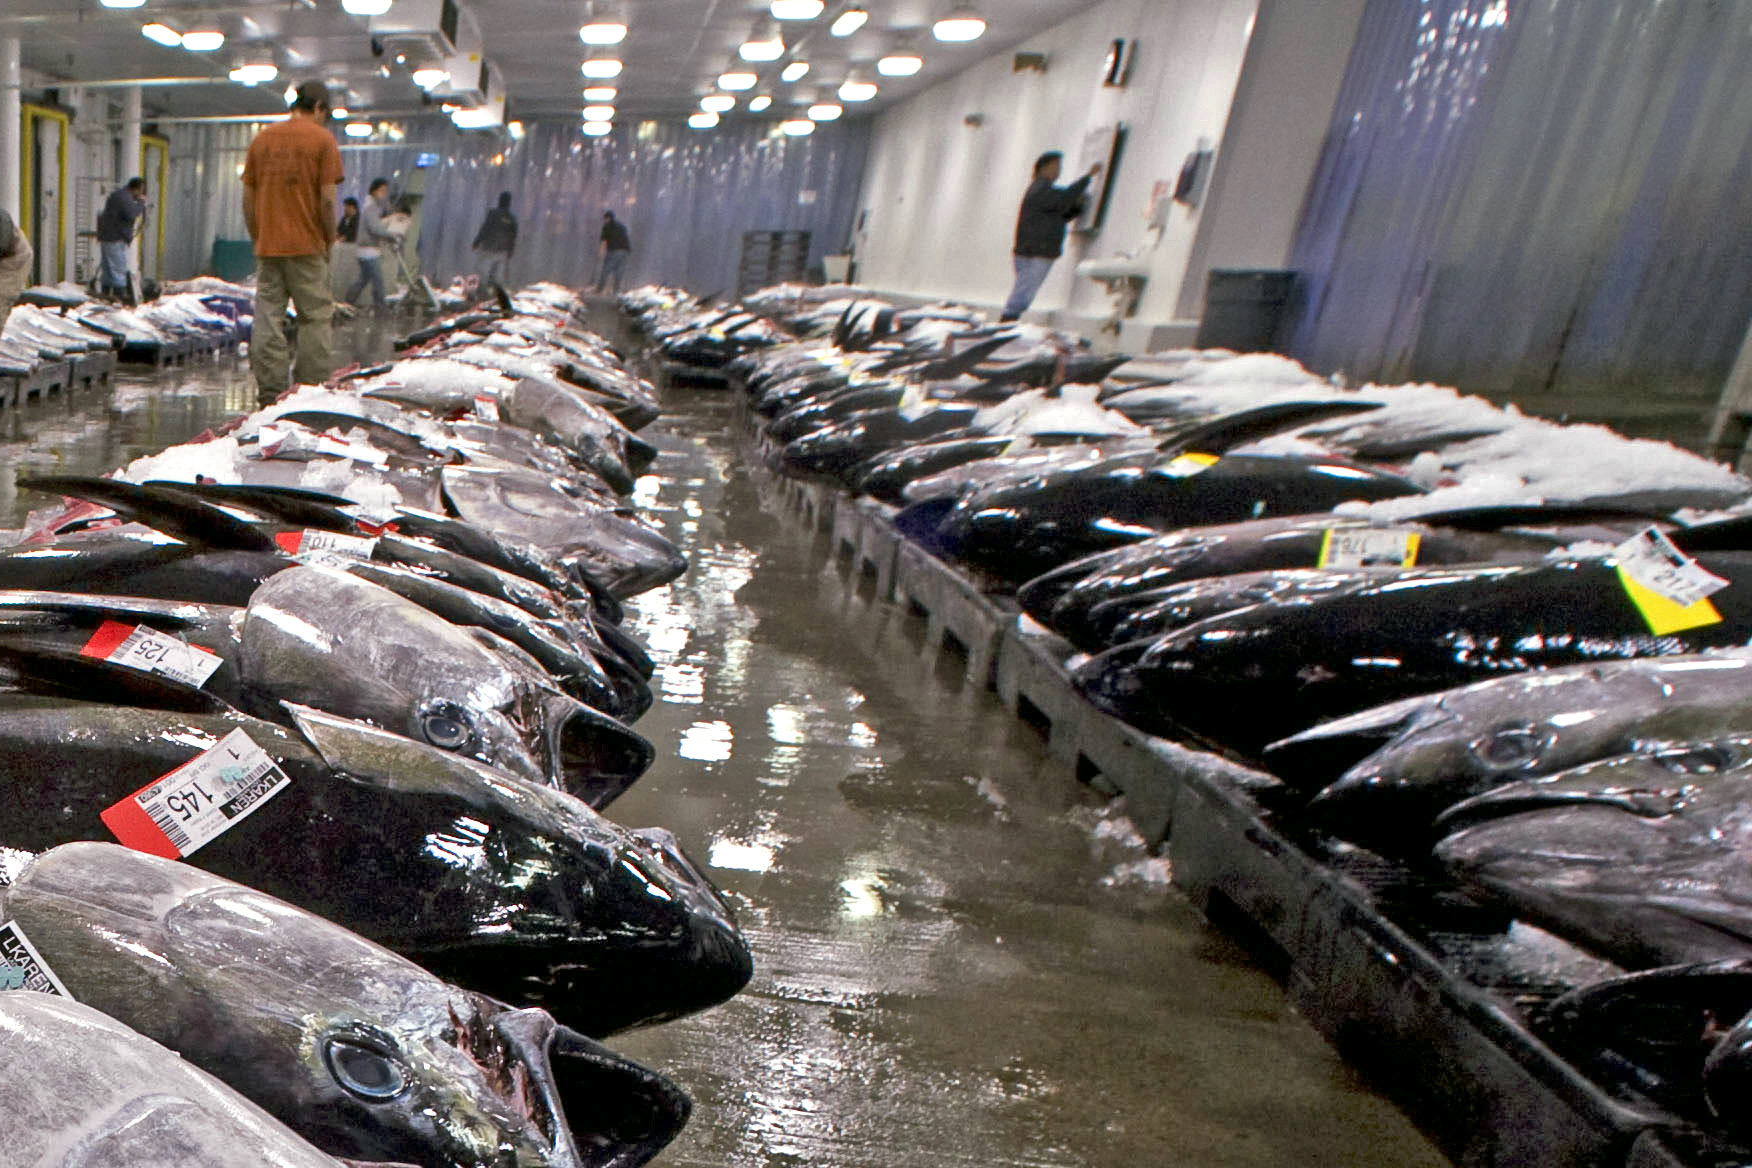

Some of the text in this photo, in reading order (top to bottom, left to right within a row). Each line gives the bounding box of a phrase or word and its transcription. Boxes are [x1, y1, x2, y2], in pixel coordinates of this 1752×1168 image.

[134, 640, 171, 663] 125
[227, 748, 241, 760] 1
[167, 781, 216, 821] 145
[230, 775, 279, 813] LKAREN
[2, 937, 56, 995] LKAREN
